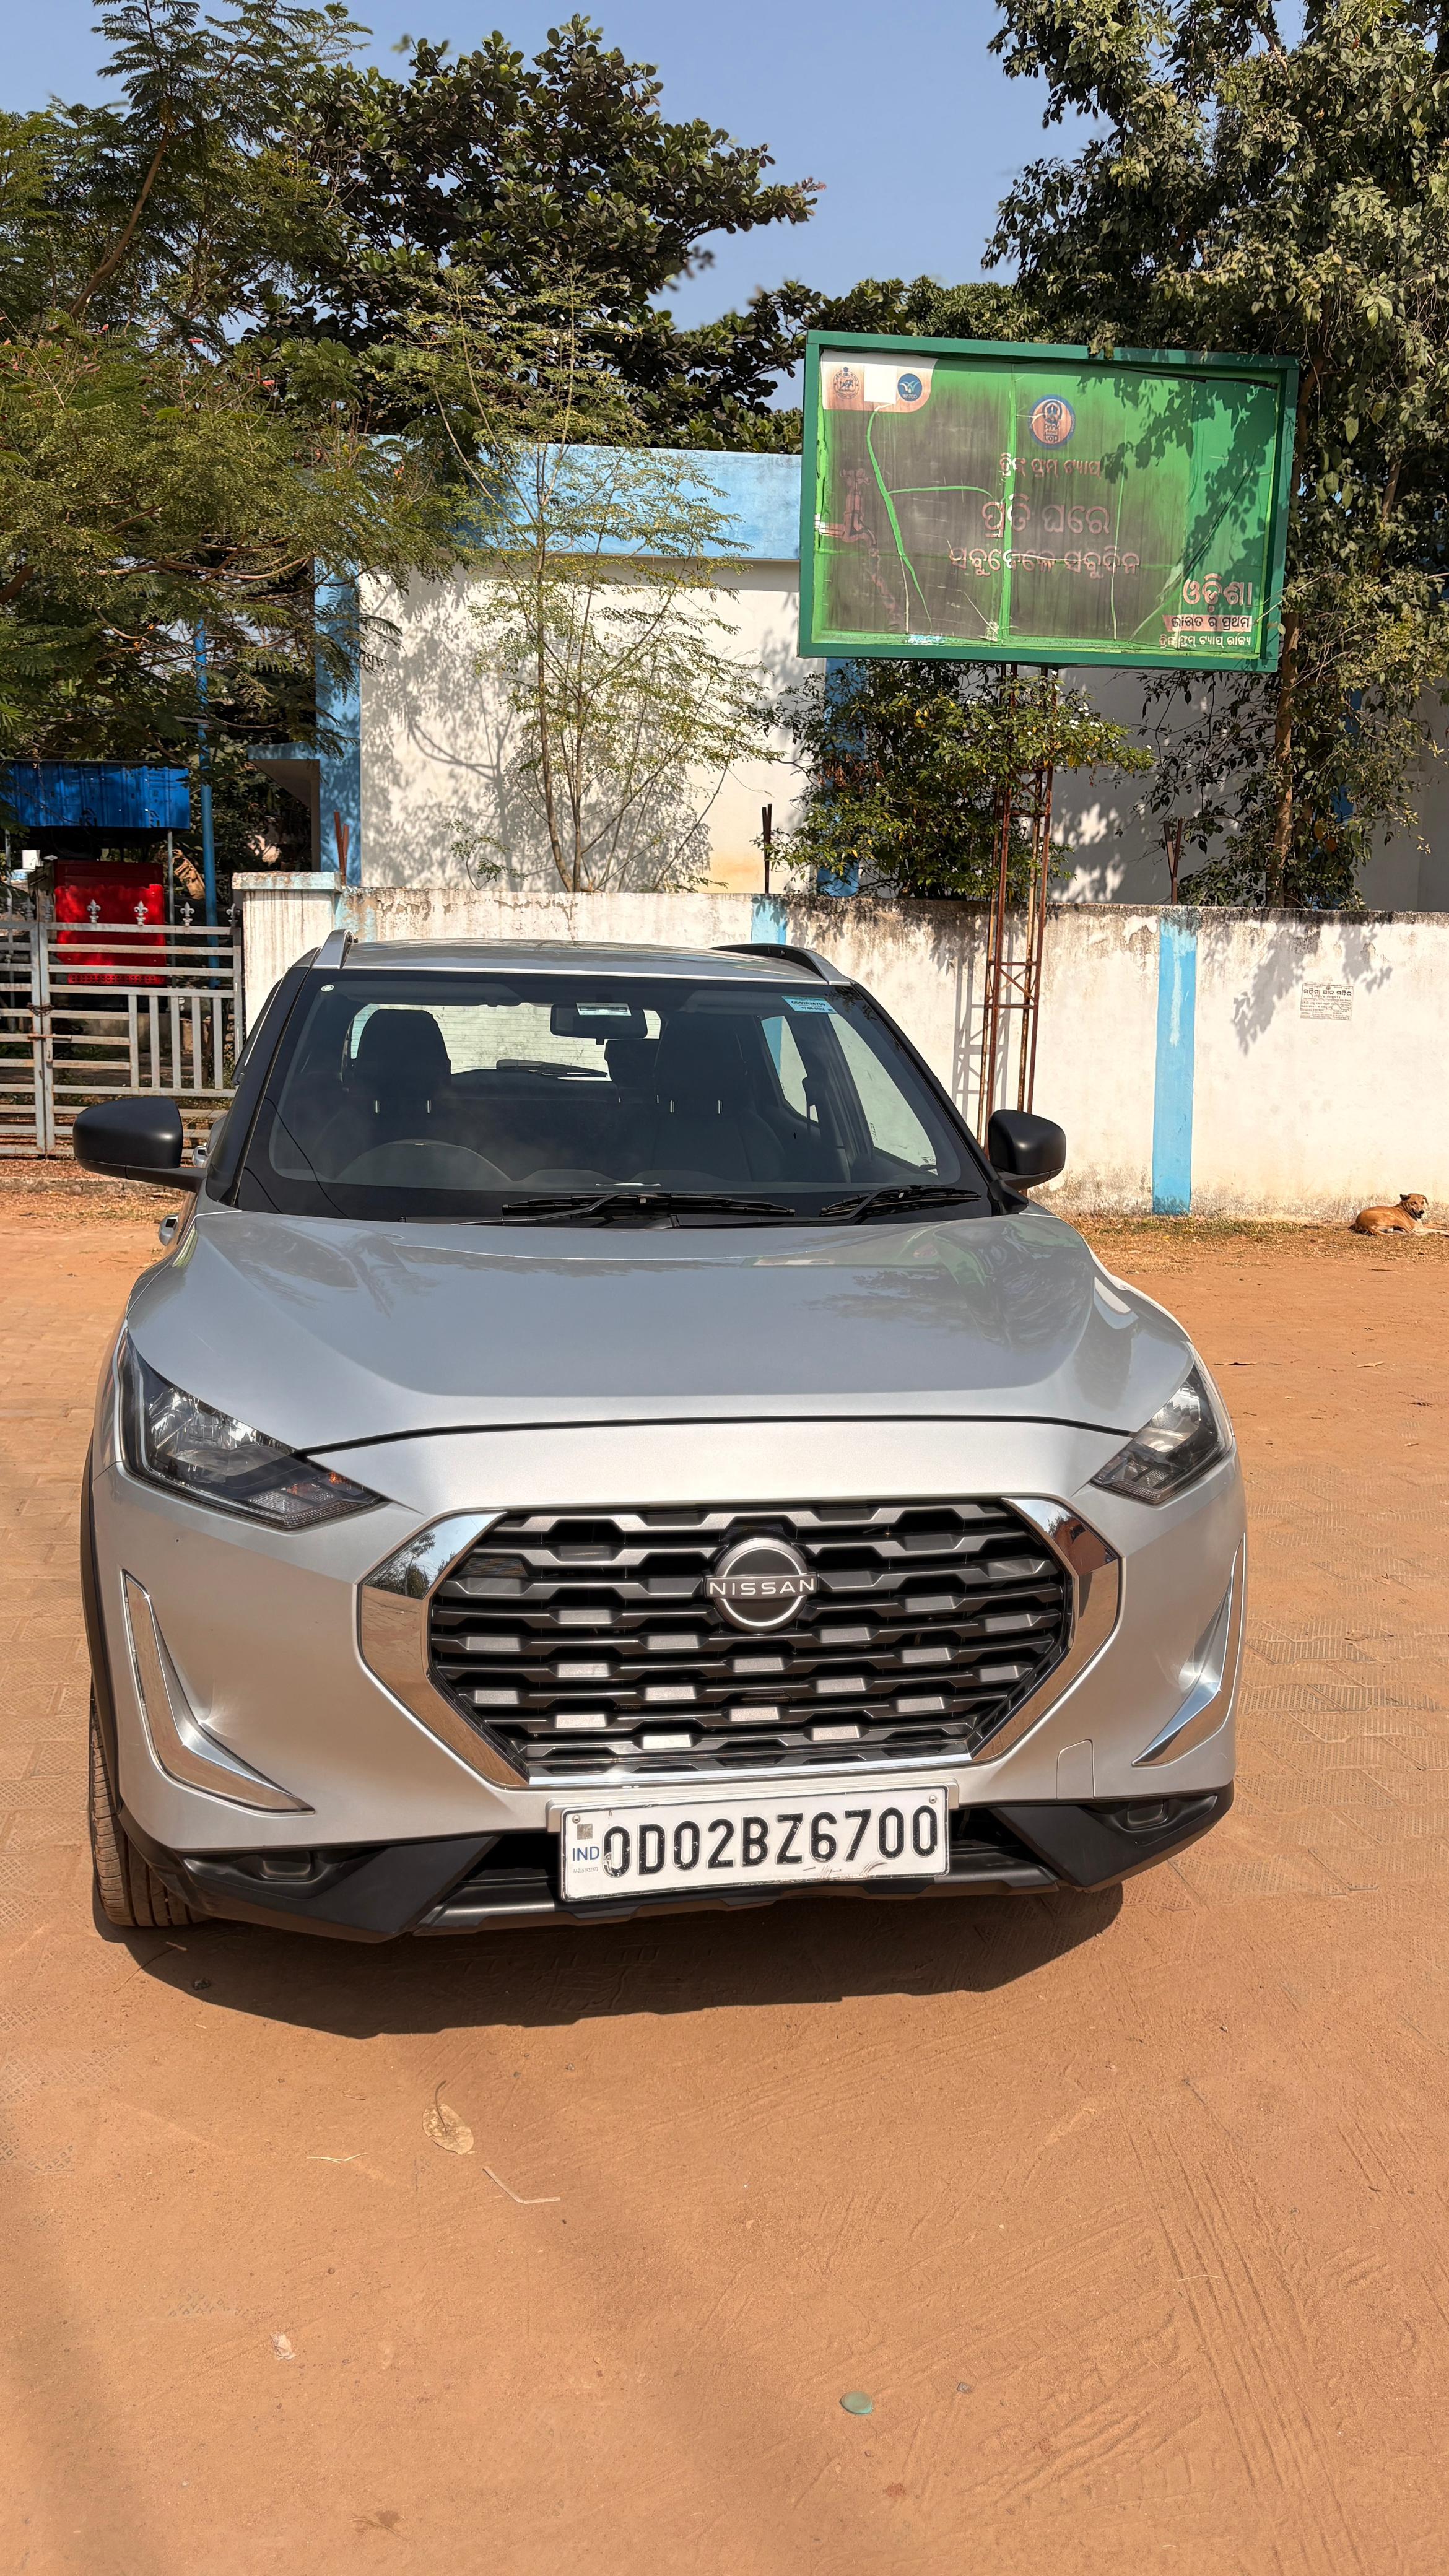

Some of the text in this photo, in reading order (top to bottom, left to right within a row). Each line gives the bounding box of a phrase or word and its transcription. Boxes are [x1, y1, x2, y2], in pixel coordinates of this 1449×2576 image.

[1042, 504, 1110, 534] ଘରେ
[1183, 573, 1253, 612] ଓଡ଼ିଶା
[710, 1578, 814, 1596] NISSAN
[572, 1846, 600, 1861] IND
[603, 1804, 938, 1879] OD02BZ6700
